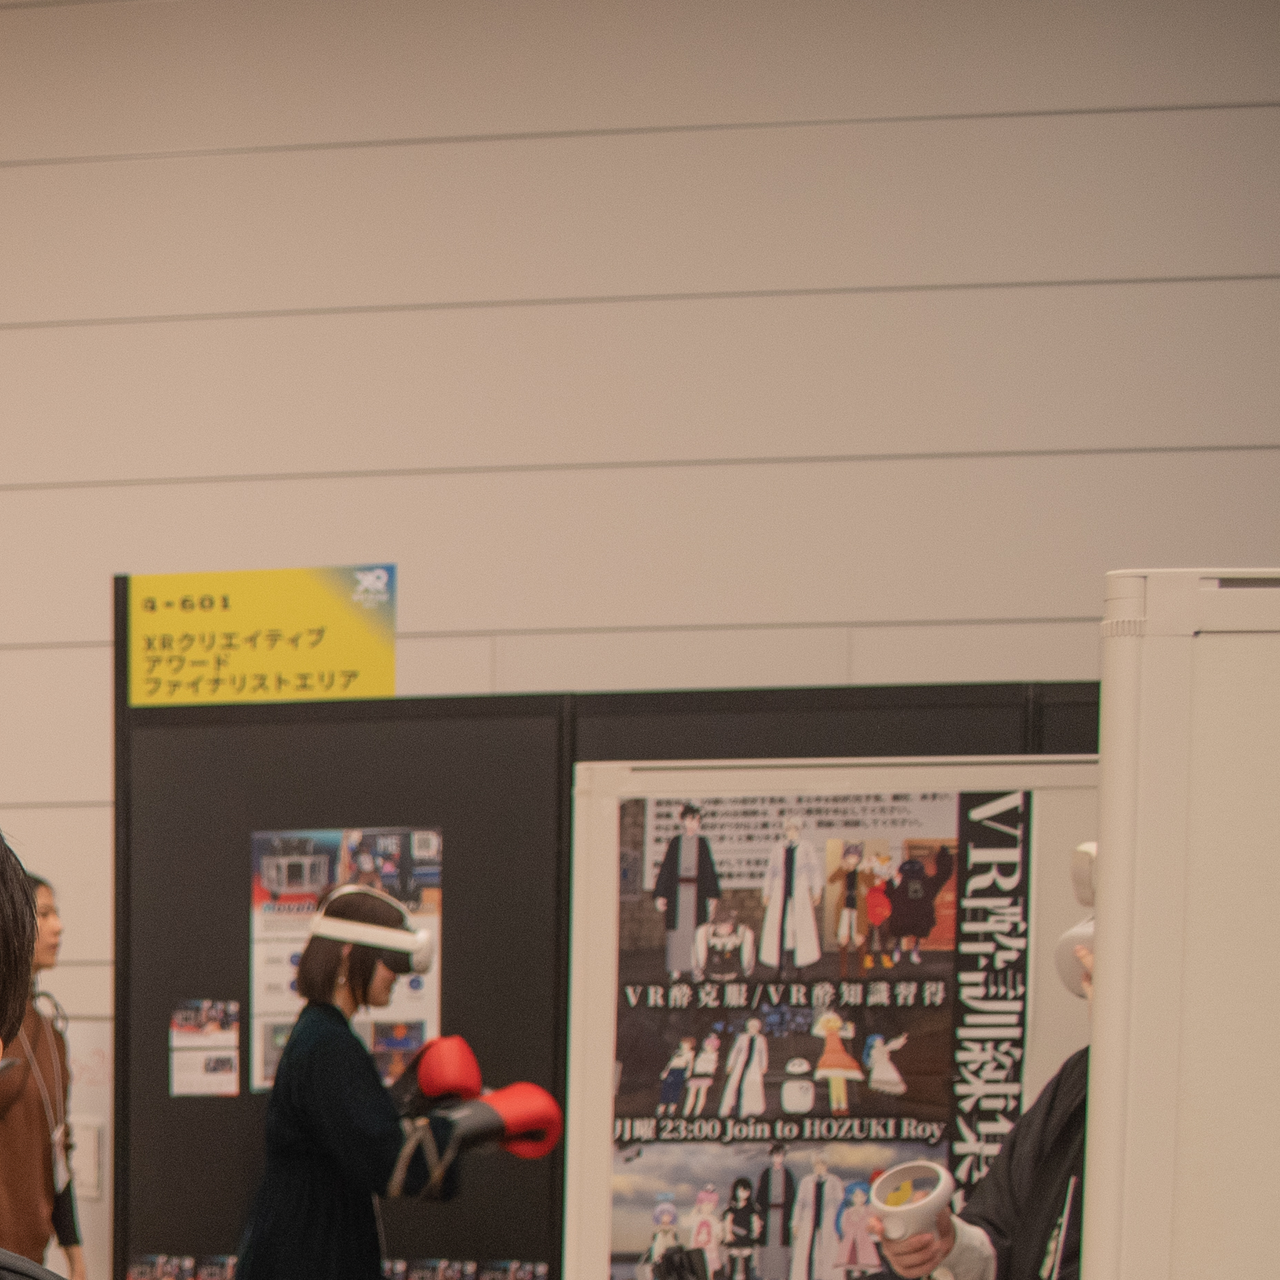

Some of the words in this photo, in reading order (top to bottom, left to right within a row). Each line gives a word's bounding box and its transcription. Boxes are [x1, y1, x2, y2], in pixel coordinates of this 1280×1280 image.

[143, 625, 327, 652] XRクリエイティブ
[144, 653, 231, 675] アワード
[144, 669, 360, 699] ファイナリストエリア
[659, 1118, 721, 1140] 23:00
[724, 1118, 771, 1142] Join
[774, 1119, 799, 1139] to
[802, 1117, 896, 1140] HOZUKI
